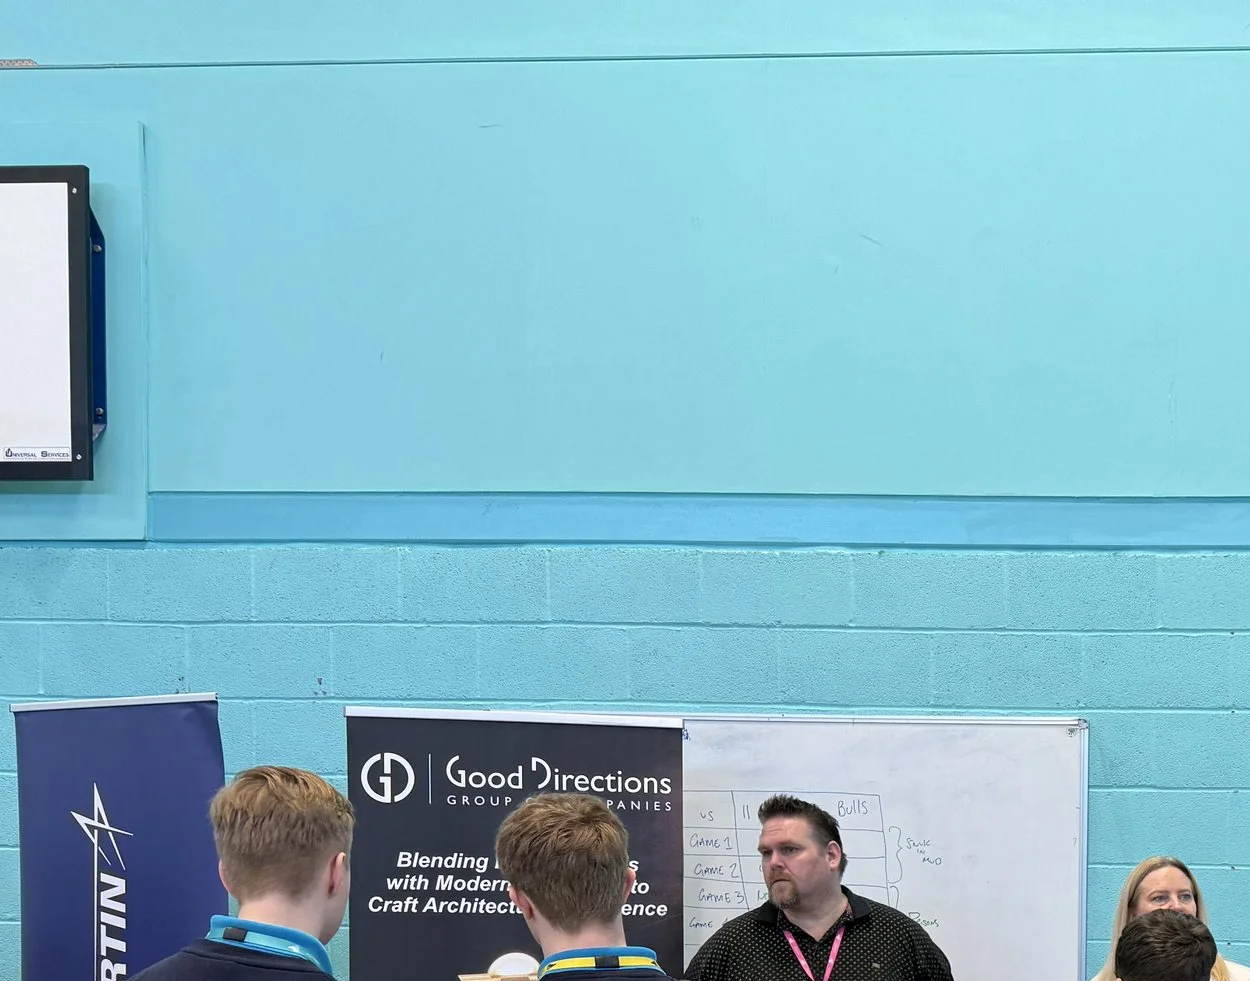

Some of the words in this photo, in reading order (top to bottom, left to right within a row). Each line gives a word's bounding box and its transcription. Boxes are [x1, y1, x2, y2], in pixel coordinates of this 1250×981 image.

[445, 755, 523, 789] Good
[531, 756, 672, 795] Directions
[447, 795, 512, 807] GROUP
[606, 800, 672, 811] PANIES
[837, 799, 869, 818] Bulls
[396, 851, 489, 873] Blending
[729, 862, 740, 879] 2
[386, 874, 429, 891] with
[435, 874, 512, 892] Modern
[368, 896, 419, 913] Craft
[422, 896, 524, 914] Architect
[734, 890, 745, 904] 3
